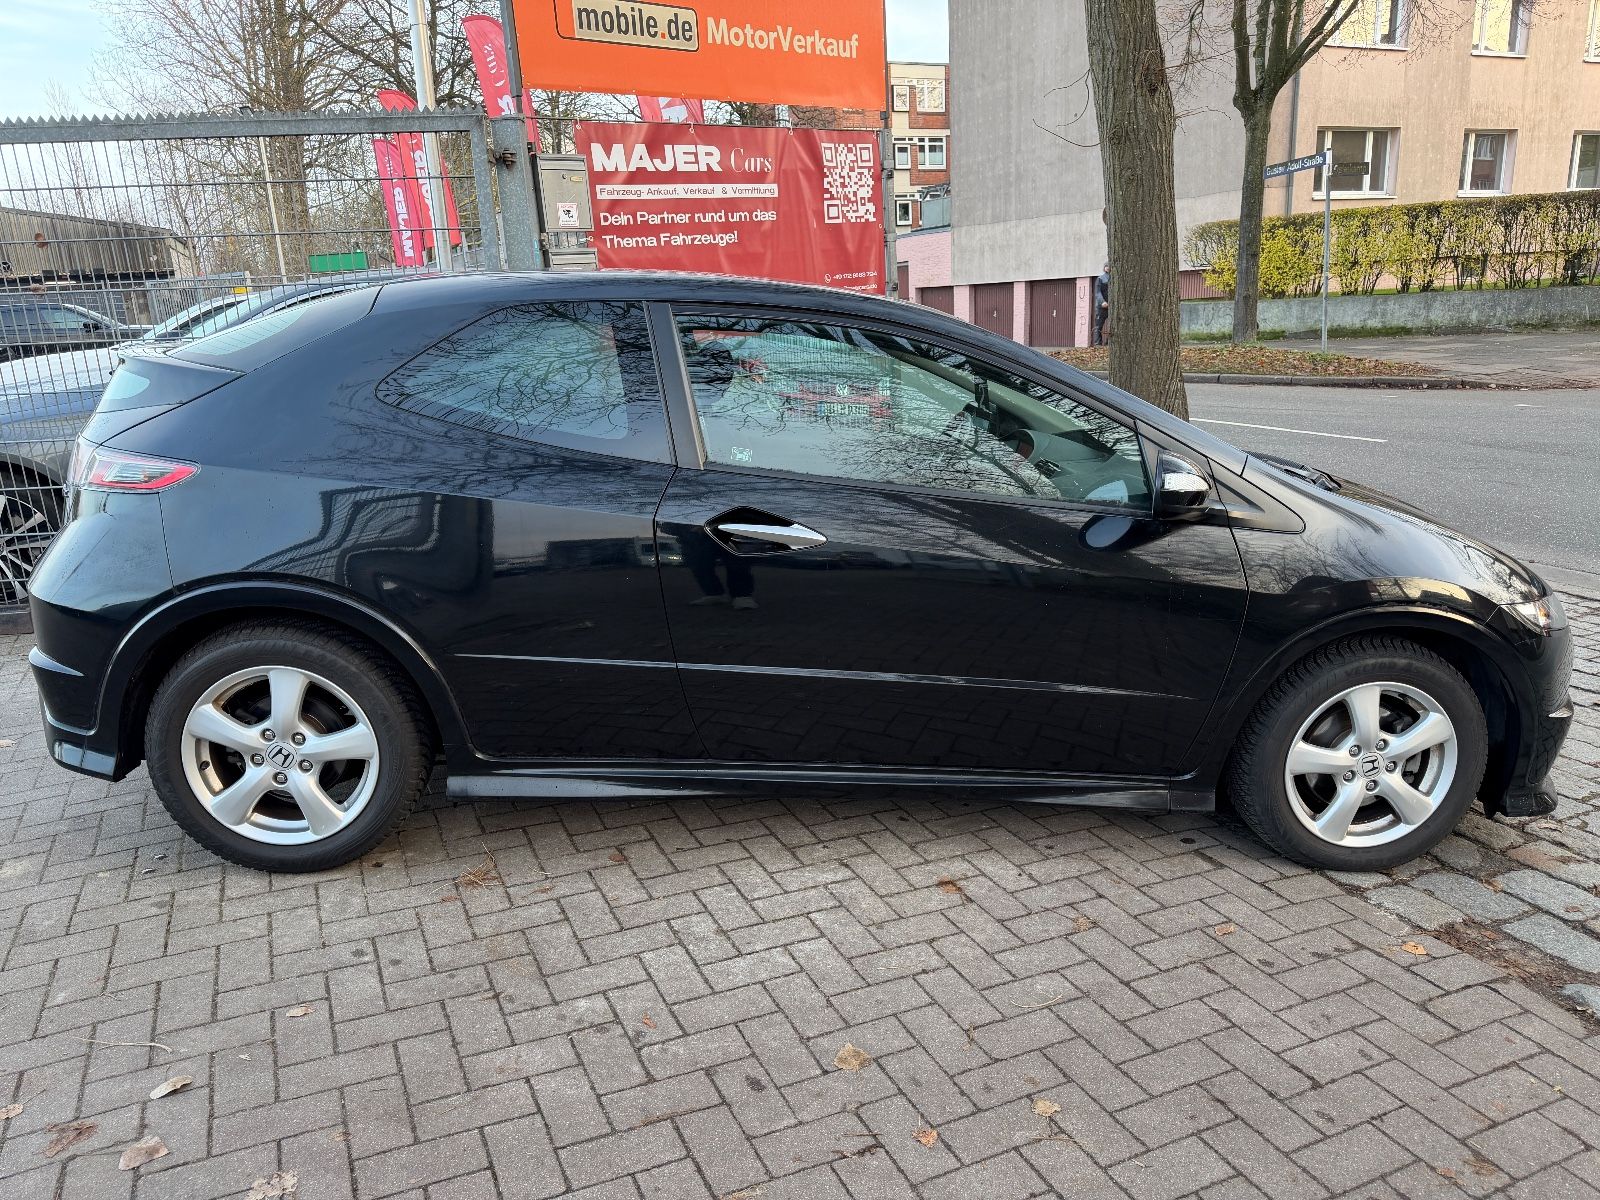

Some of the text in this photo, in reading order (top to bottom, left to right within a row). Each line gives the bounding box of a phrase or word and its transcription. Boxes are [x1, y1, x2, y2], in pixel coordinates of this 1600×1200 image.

[577, 5, 693, 42] mobile.de
[706, 17, 859, 59] MotorVerkauf
[590, 142, 772, 173] MAJER Cars
[599, 187, 644, 198] Fahrzeug-
[683, 186, 715, 196] Verkauf
[721, 186, 728, 195] &
[731, 186, 775, 196] Vermittlung
[600, 208, 777, 226] Dein Partner rund um das
[602, 230, 738, 249] Thema Fahrzeuge!
